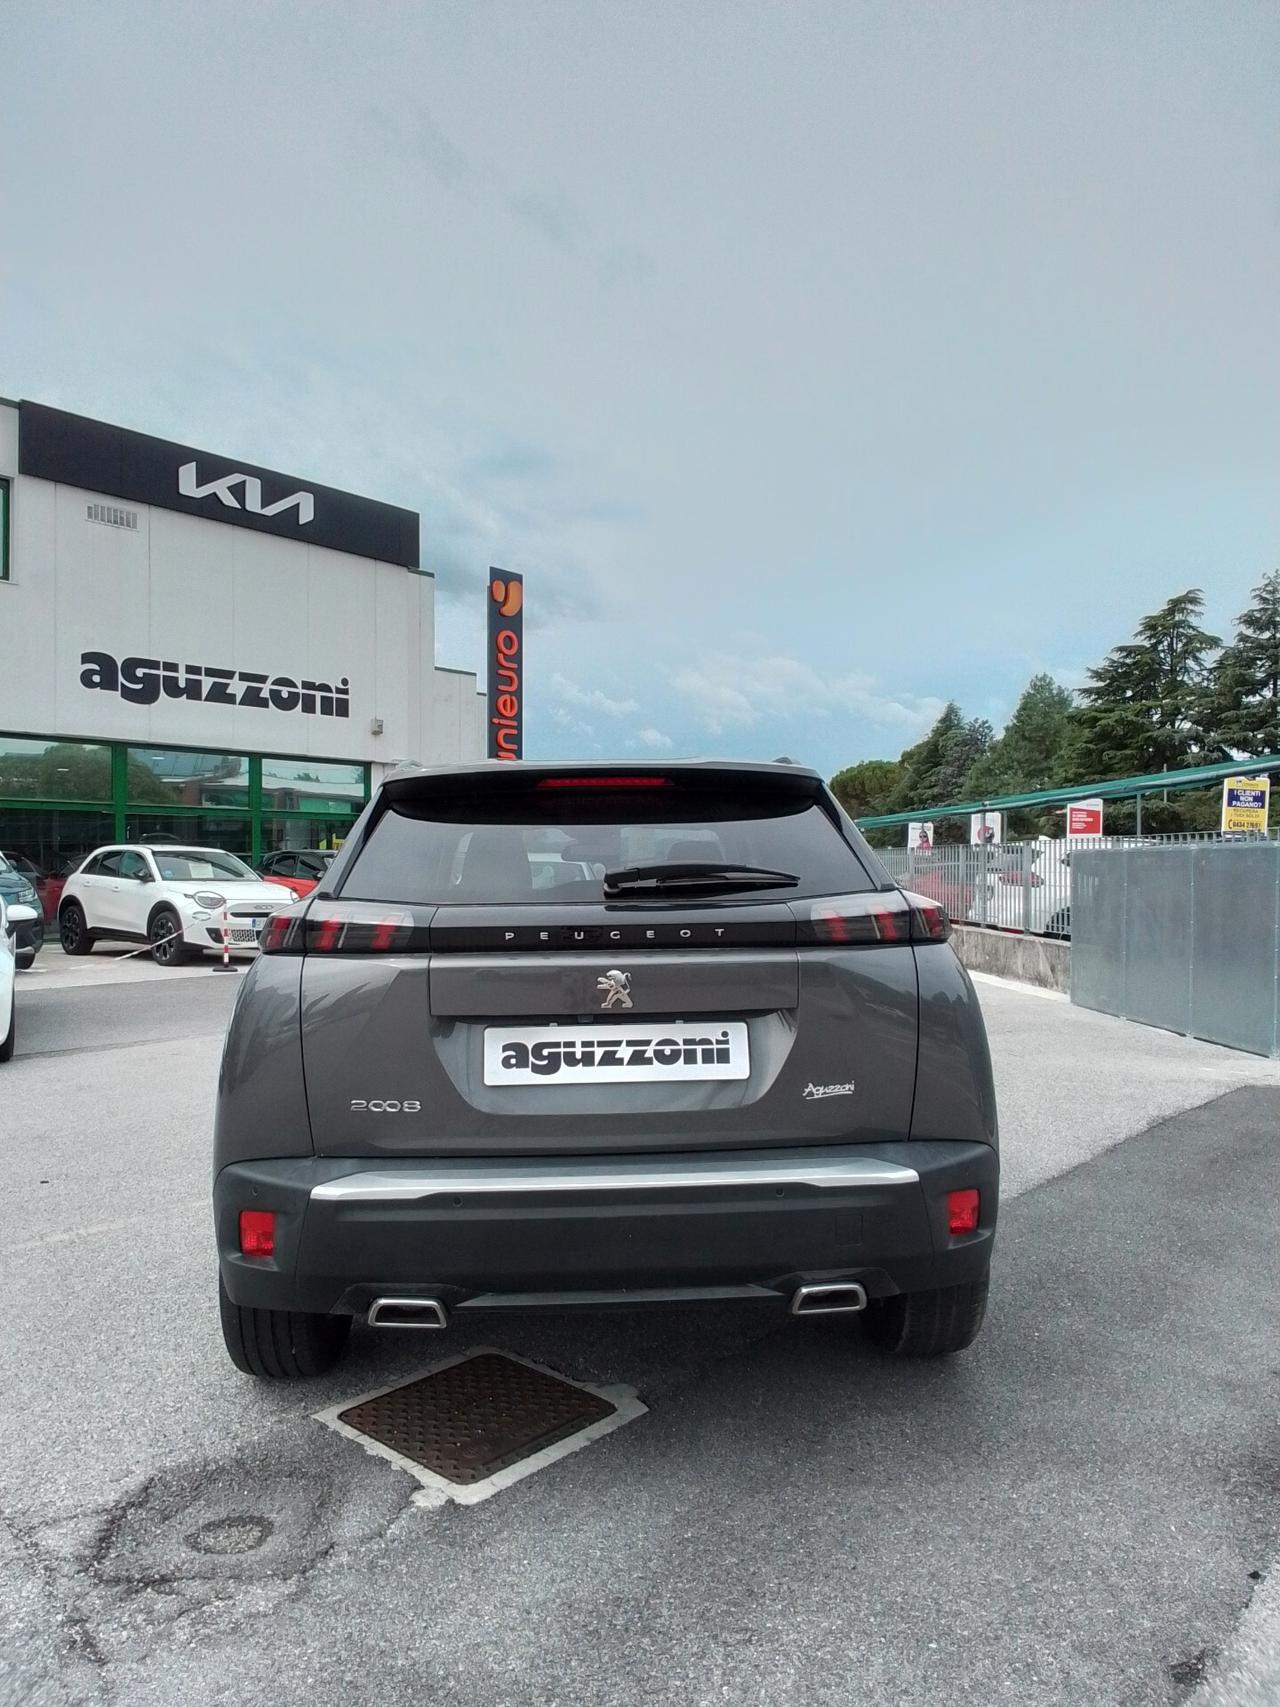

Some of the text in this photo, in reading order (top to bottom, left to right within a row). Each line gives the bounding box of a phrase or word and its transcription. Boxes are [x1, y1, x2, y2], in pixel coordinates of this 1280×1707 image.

[80, 651, 350, 718] aguzzoni
[504, 928, 725, 941] PEUGEOT
[501, 1030, 731, 1076] aguzzoni
[802, 1080, 855, 1098] Aguzzoni
[350, 1100, 421, 1112] 2008
